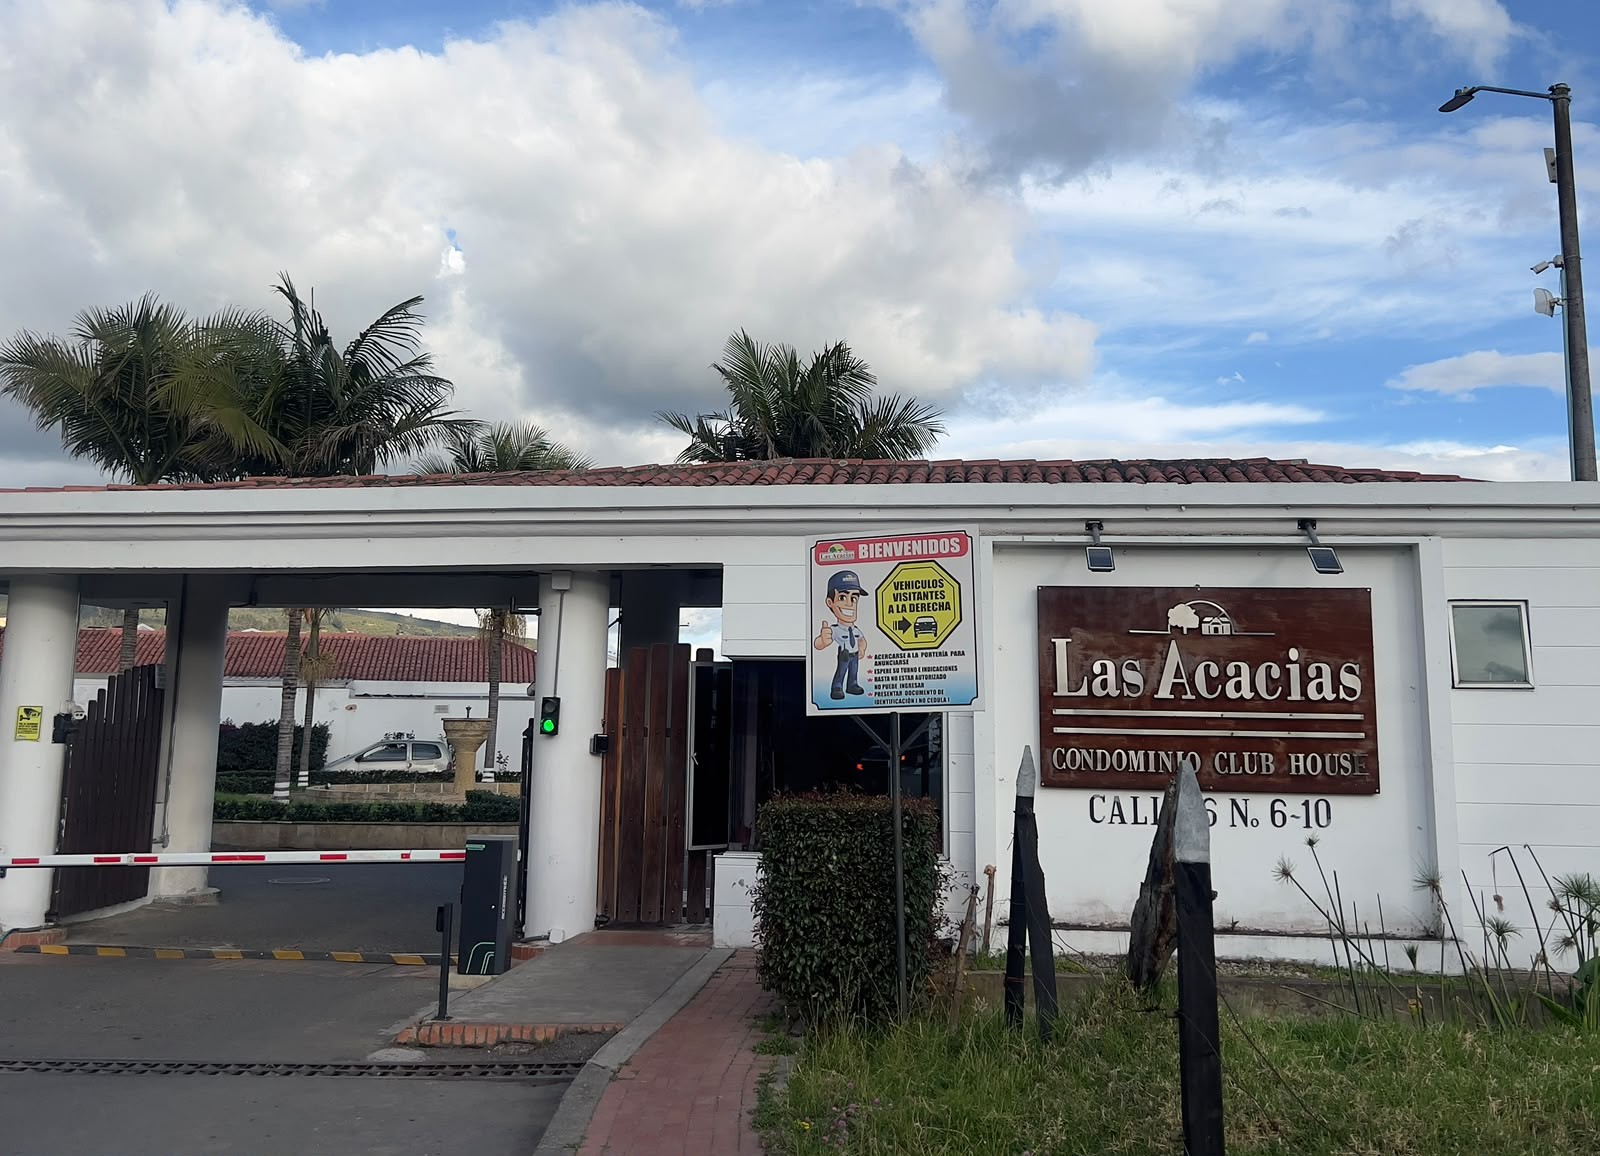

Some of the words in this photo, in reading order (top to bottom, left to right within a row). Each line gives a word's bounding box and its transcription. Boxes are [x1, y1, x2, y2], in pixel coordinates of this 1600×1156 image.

[858, 537, 960, 559] BIENVENIDOS
[893, 578, 944, 591] VEHICULOS
[892, 590, 946, 602] VISITANTES
[887, 606, 895, 614] A
[896, 604, 908, 614] LA
[909, 601, 952, 613] DERECHA
[874, 652, 906, 660] ACERCARSE
[1051, 638, 1144, 698] Las
[1154, 639, 1362, 701] Acacias
[1052, 747, 1201, 774] CONDOMINIO
[1214, 750, 1275, 774] CLUB
[1289, 752, 1370, 776] HOUSE
[1089, 794, 1160, 825] CALL
